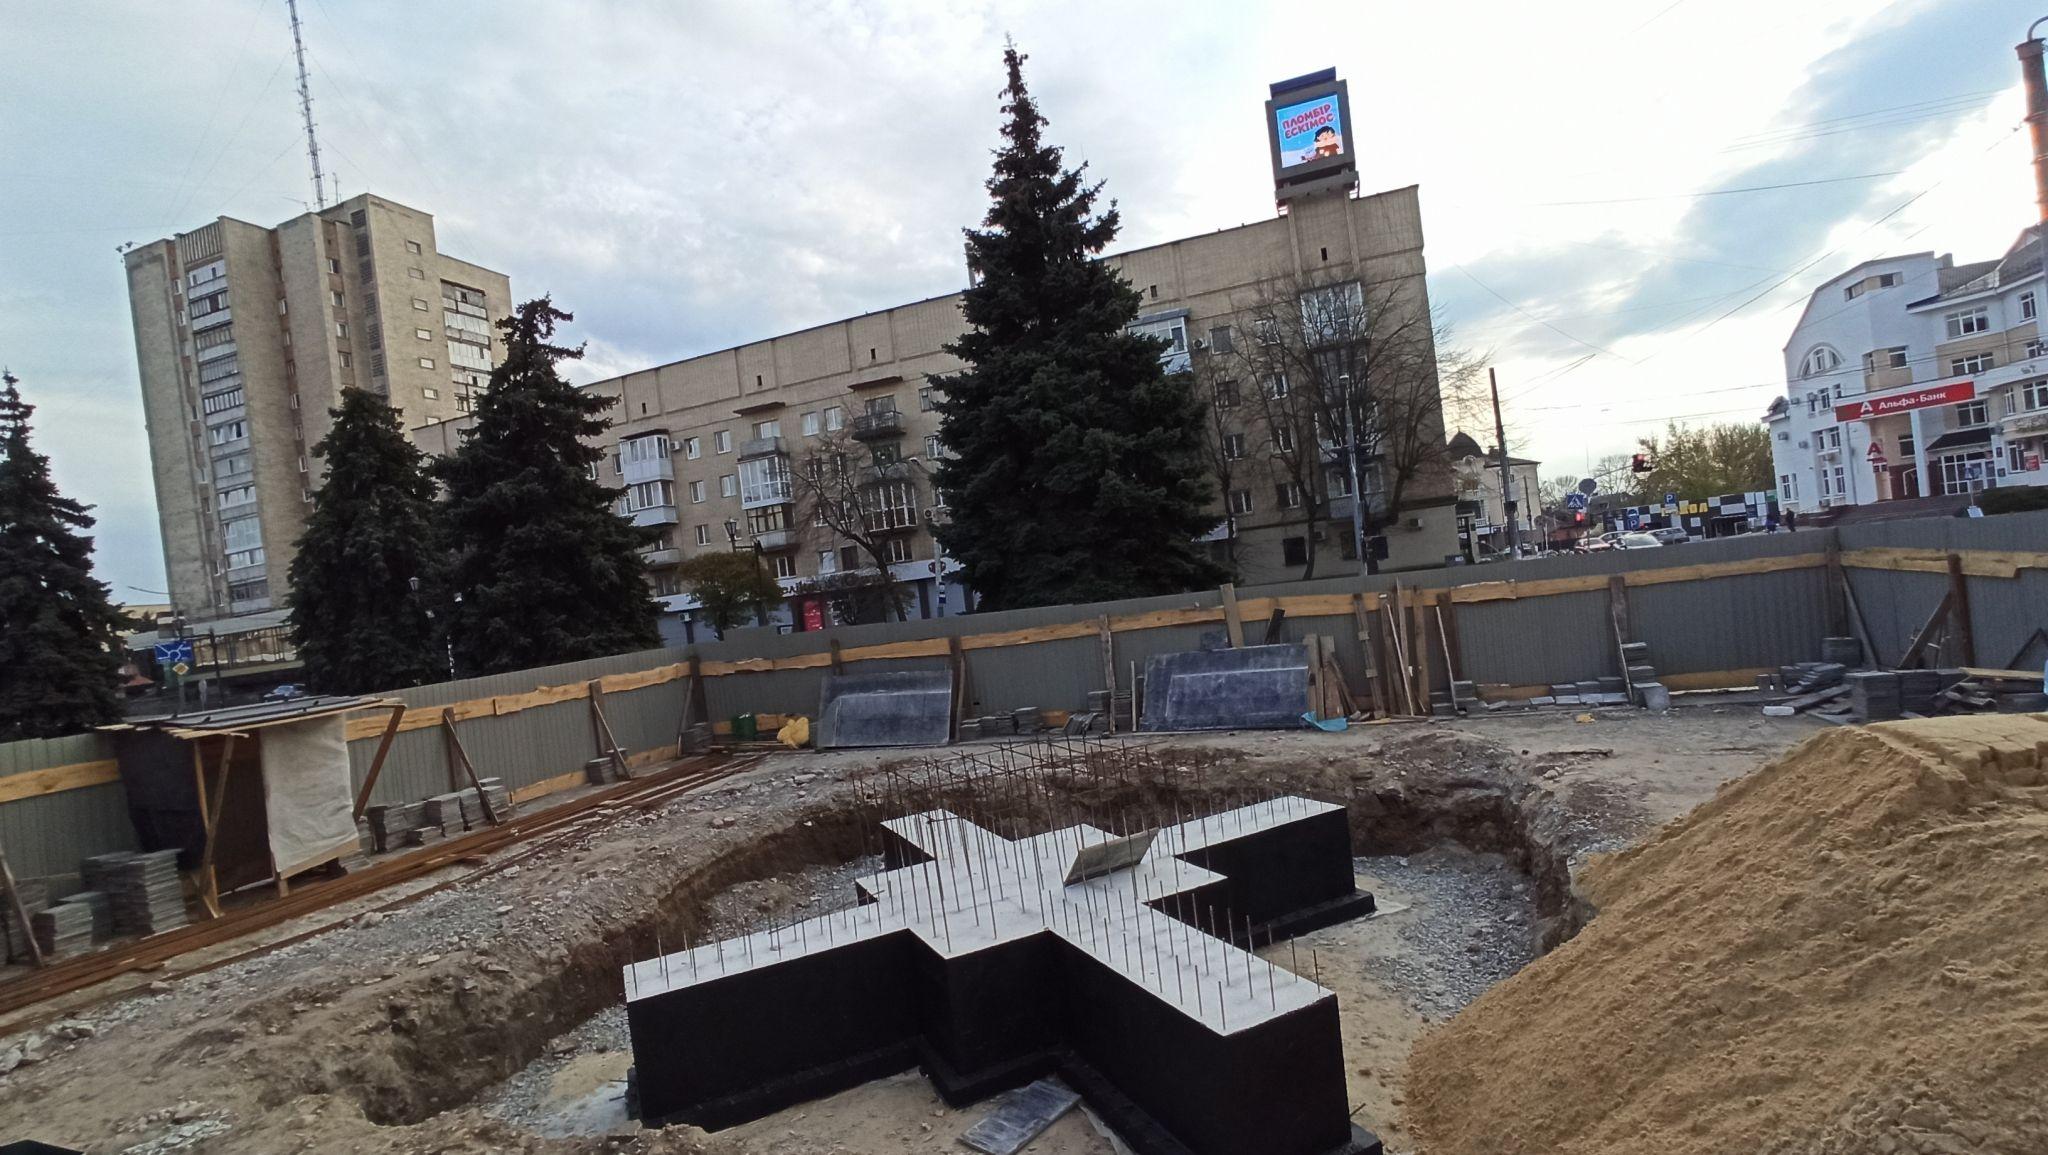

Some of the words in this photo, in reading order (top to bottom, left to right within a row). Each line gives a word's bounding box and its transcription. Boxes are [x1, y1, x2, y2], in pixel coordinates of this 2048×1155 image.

[1283, 104, 1331, 128] ПЛОМБІР
[1285, 114, 1333, 139] ЕСКІМОС
[1879, 392, 1946, 410] Альфа-Банк
[1666, 494, 1673, 502] P
